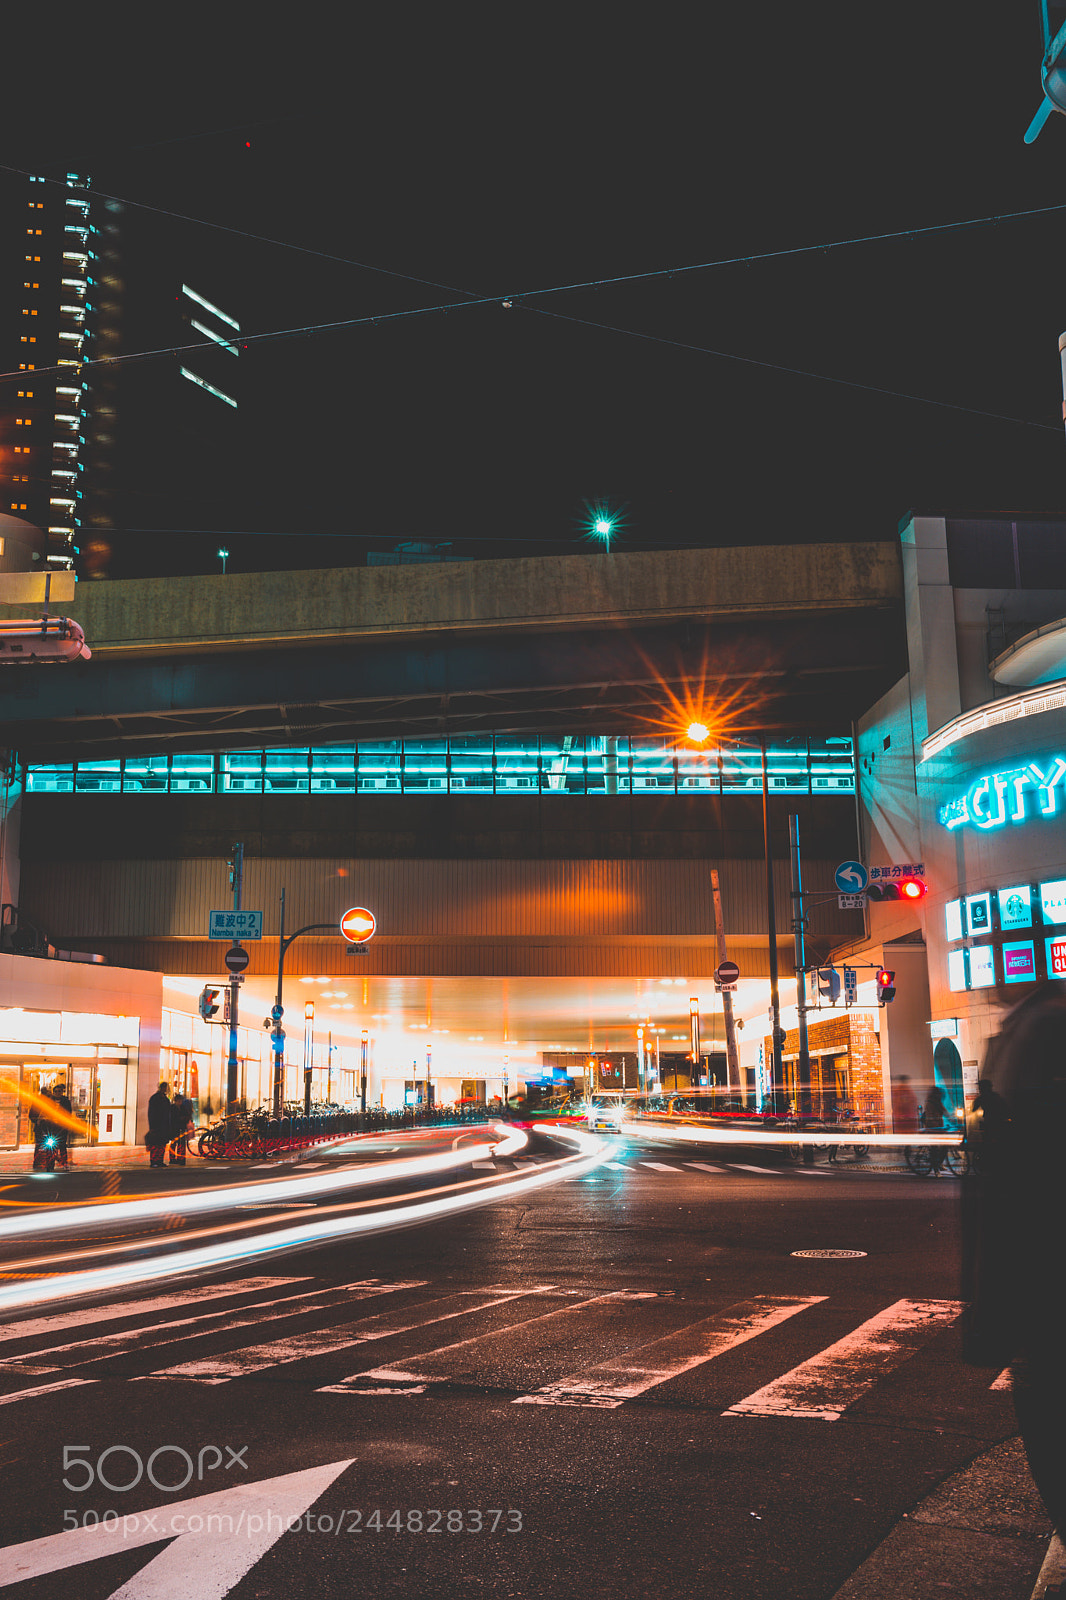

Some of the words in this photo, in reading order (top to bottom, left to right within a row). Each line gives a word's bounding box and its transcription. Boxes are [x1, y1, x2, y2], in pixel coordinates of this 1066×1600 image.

[966, 758, 1066, 829] CITY
[870, 865, 924, 879] 歩車分離式
[212, 928, 234, 937] Namba
[236, 929, 252, 937] naka
[254, 929, 259, 937] 2
